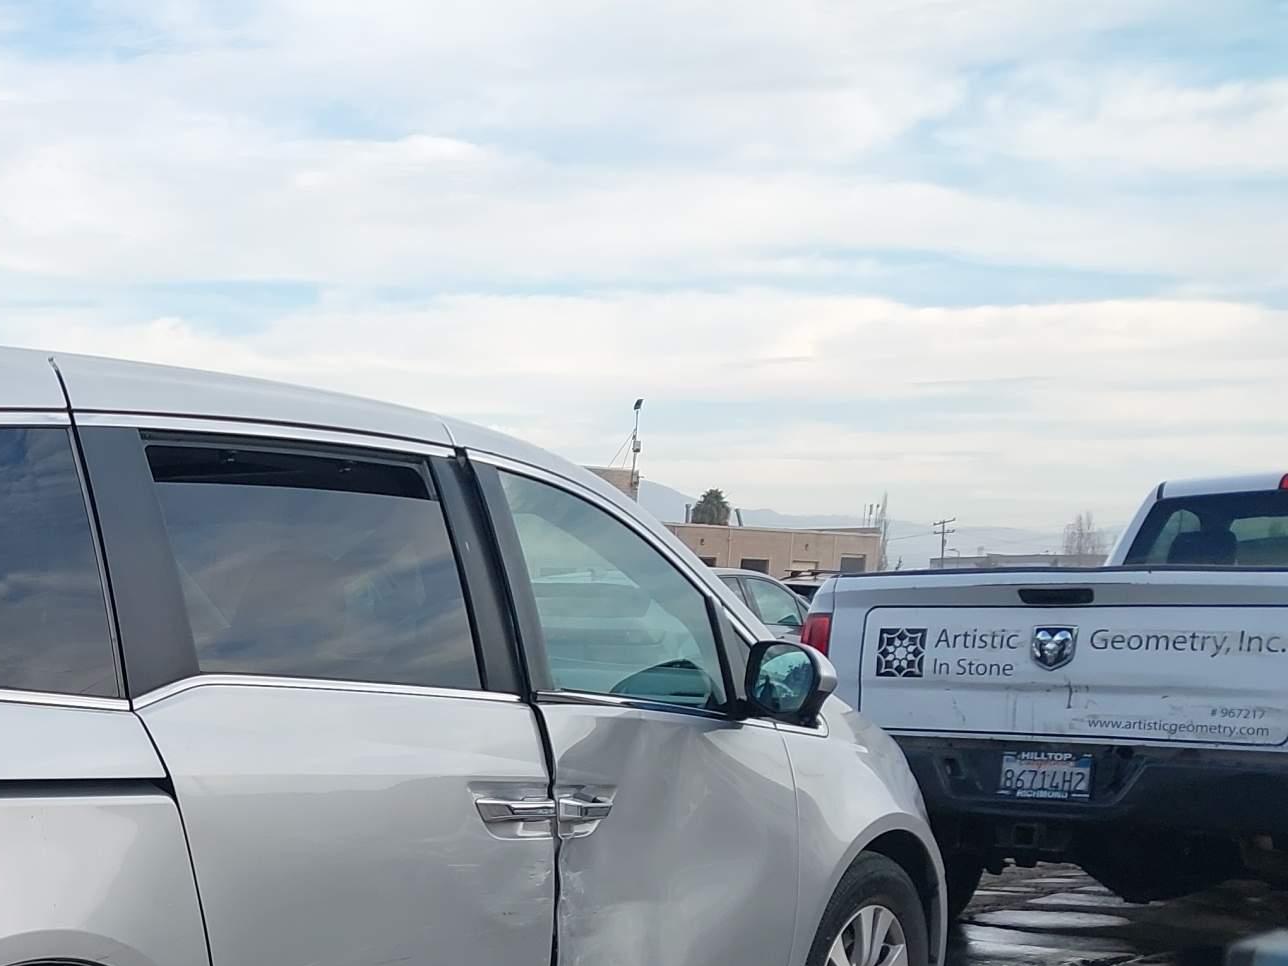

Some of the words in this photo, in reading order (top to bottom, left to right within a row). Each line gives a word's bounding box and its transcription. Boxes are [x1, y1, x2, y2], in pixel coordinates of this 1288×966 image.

[934, 628, 1019, 650] Artistic
[1089, 628, 1230, 658] Geometry,
[1238, 630, 1287, 653] Inc.
[933, 658, 950, 675] In
[956, 658, 1014, 676] Stone
[1220, 707, 1266, 720] 967217
[1087, 718, 1270, 738] www.artisticgeometry.com
[1021, 751, 1073, 761] HILLTOP
[1004, 769, 1087, 791] 86714H2
